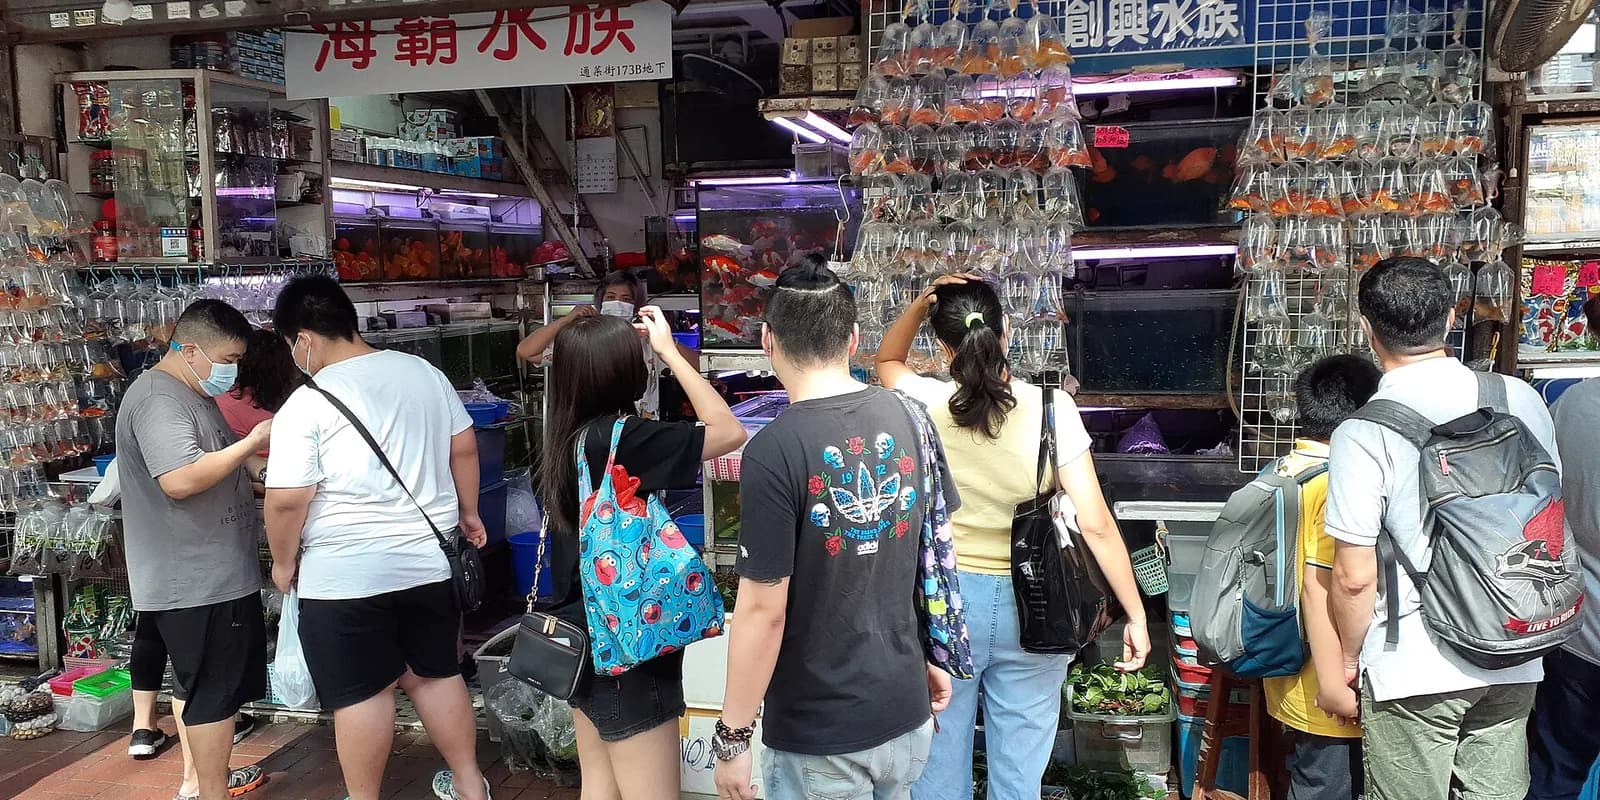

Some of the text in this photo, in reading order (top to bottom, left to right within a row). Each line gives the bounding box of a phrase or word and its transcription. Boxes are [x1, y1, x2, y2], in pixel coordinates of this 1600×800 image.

[1064, 0, 1240, 48] 創興水族
[312, 4, 636, 72] 海霸水族
[579, 62, 666, 78] 通菜街173B地下
[841, 463, 887, 485] 19 72
[1527, 606, 1577, 633] LIVE TO RIDE
